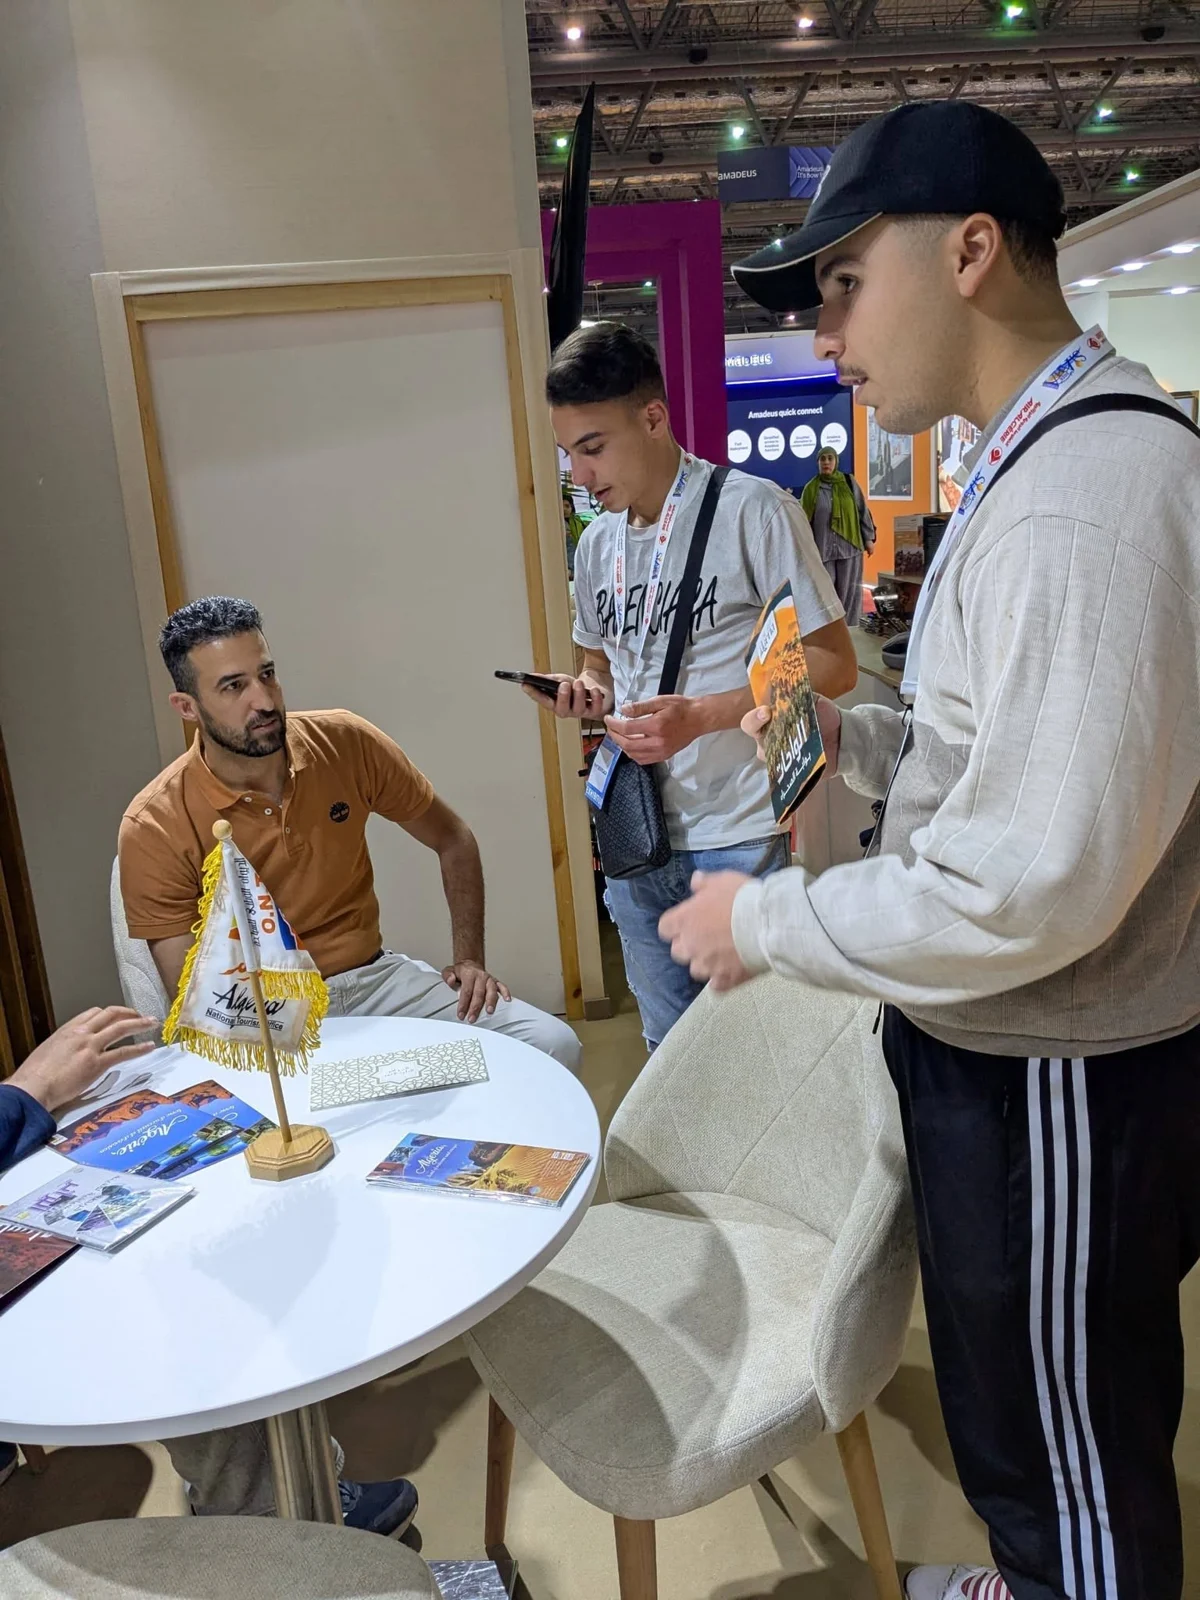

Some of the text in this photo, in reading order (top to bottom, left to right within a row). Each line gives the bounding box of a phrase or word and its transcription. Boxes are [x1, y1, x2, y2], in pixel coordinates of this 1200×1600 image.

[748, 406, 823, 419] Amadeus quick connect
[776, 717, 807, 785] الواحات
[212, 982, 288, 1029] Algea
[267, 1020, 284, 1031] ffice
